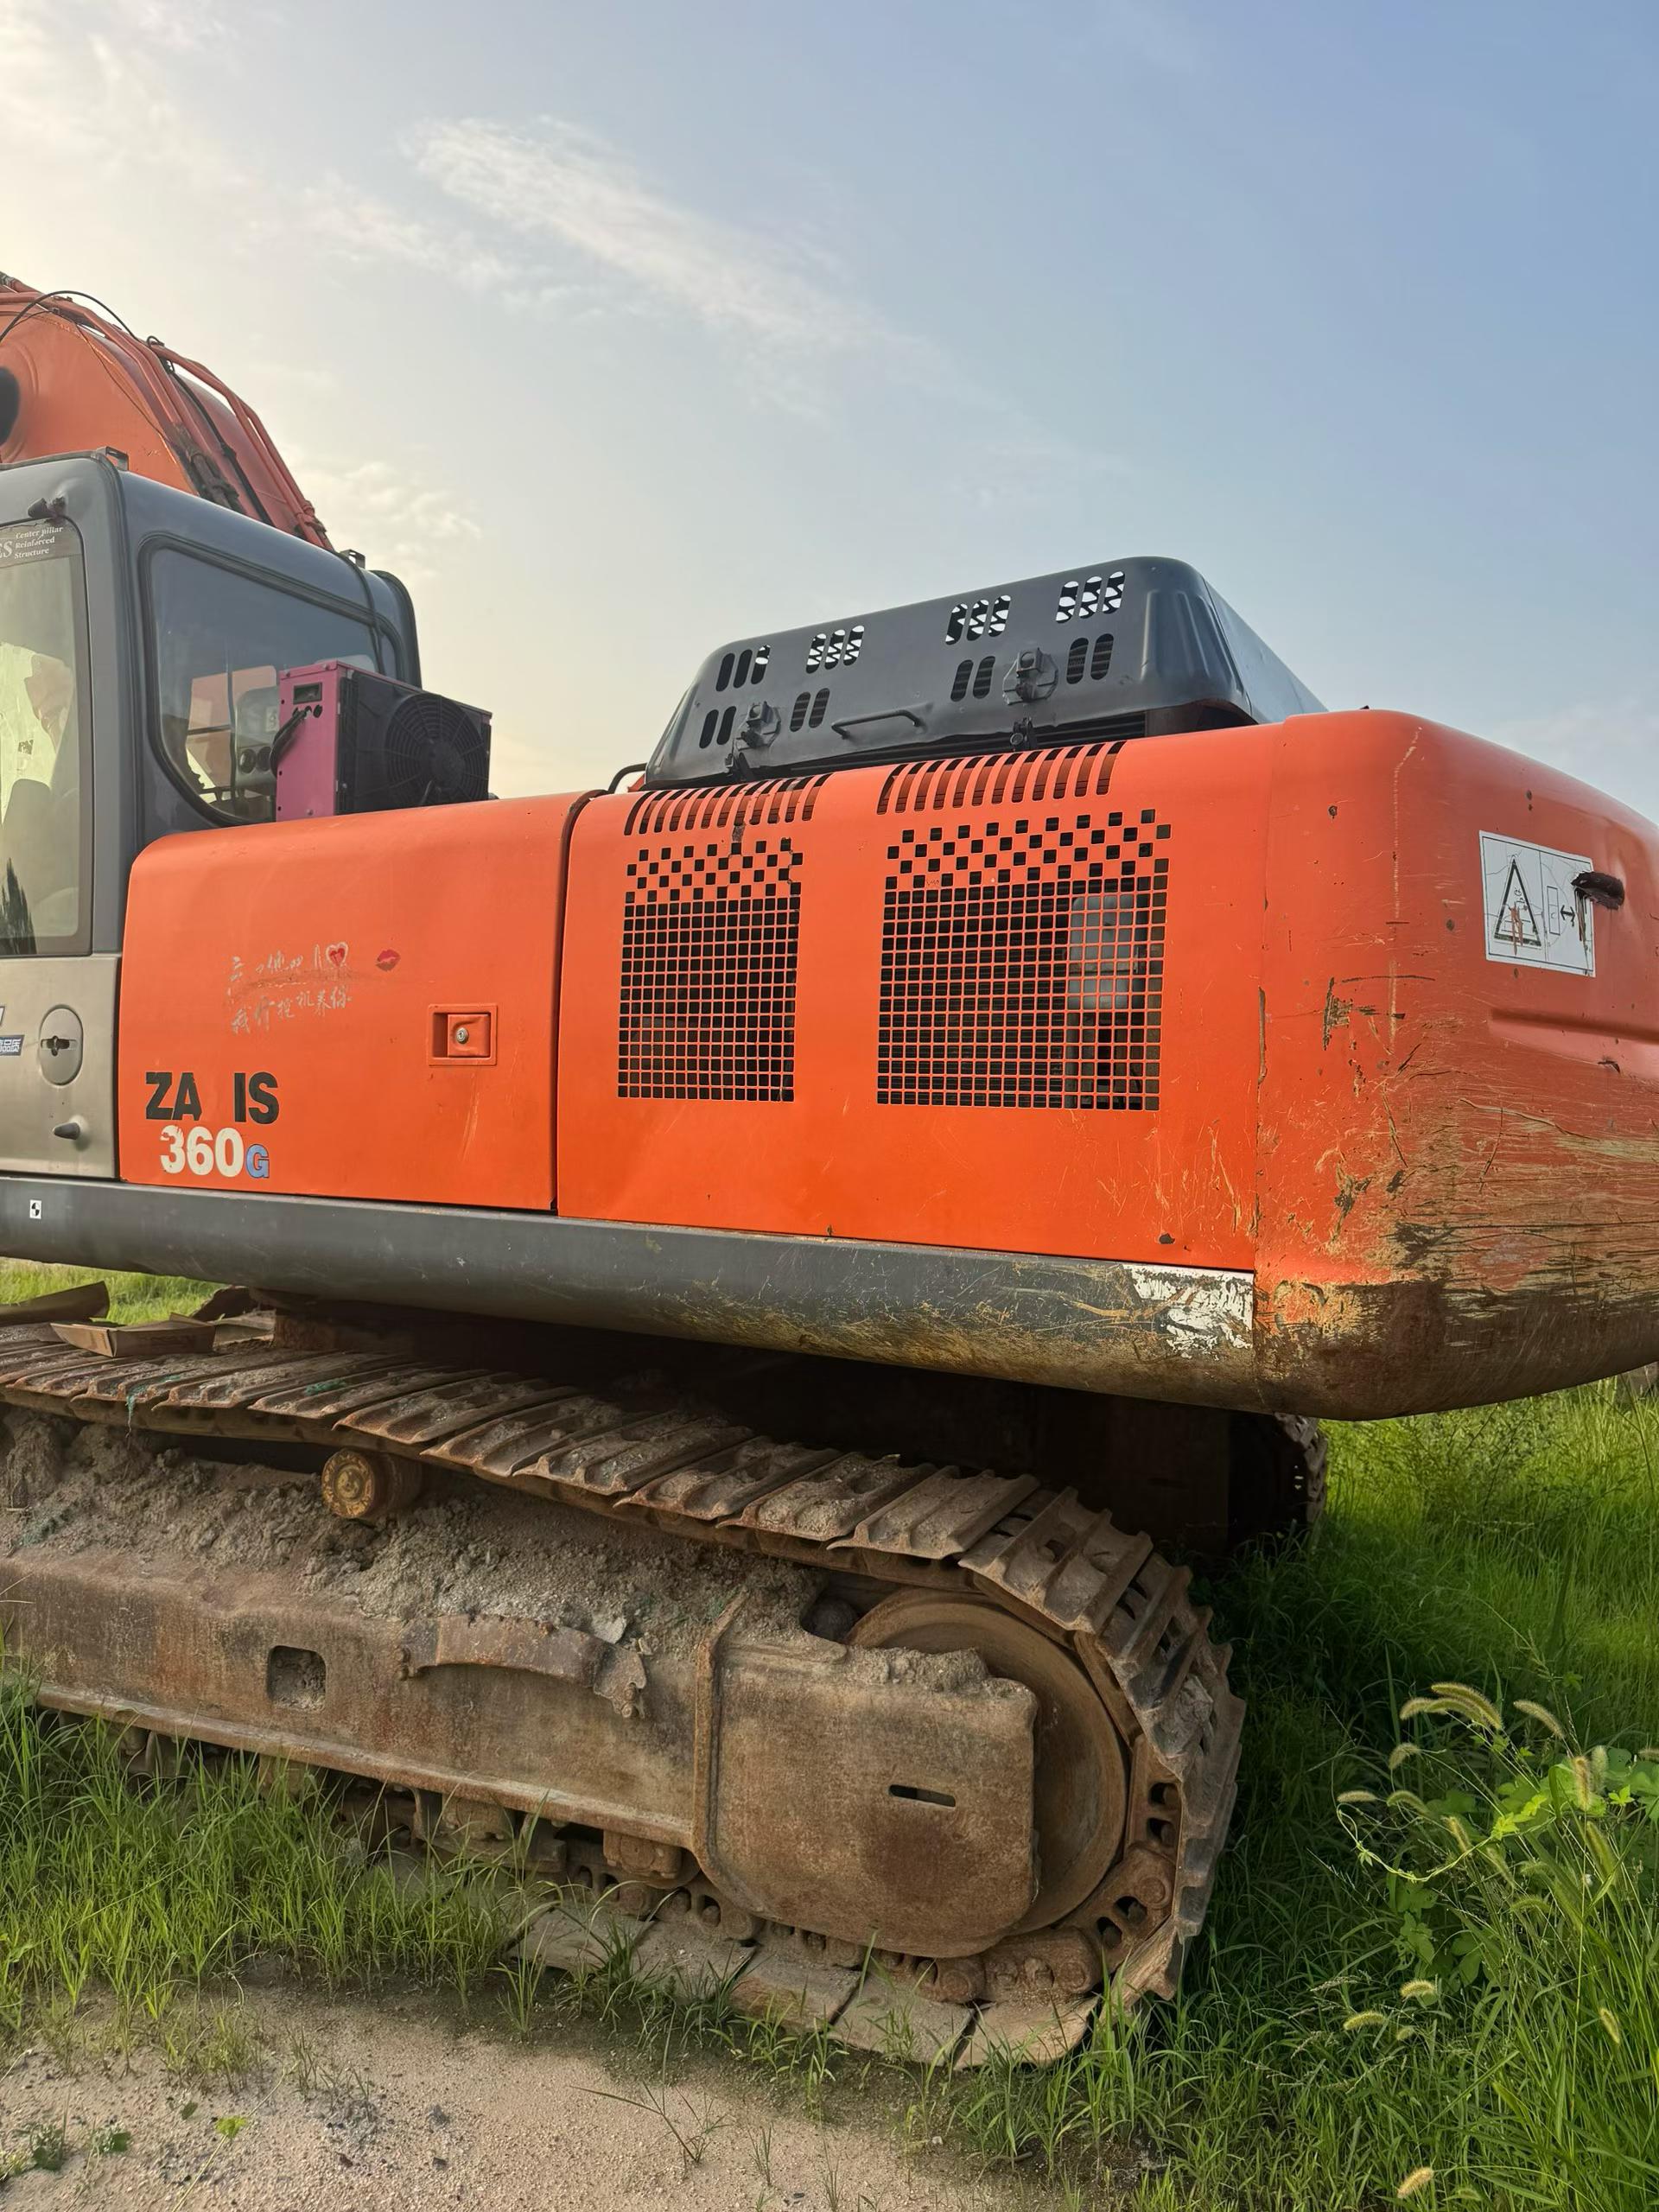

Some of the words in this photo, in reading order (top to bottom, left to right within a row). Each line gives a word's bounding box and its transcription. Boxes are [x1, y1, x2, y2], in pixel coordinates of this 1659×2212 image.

[16, 530, 40, 539] Center
[38, 526, 63, 540] pillar
[16, 536, 55, 549] Reinforced
[14, 548, 49, 559] Structure
